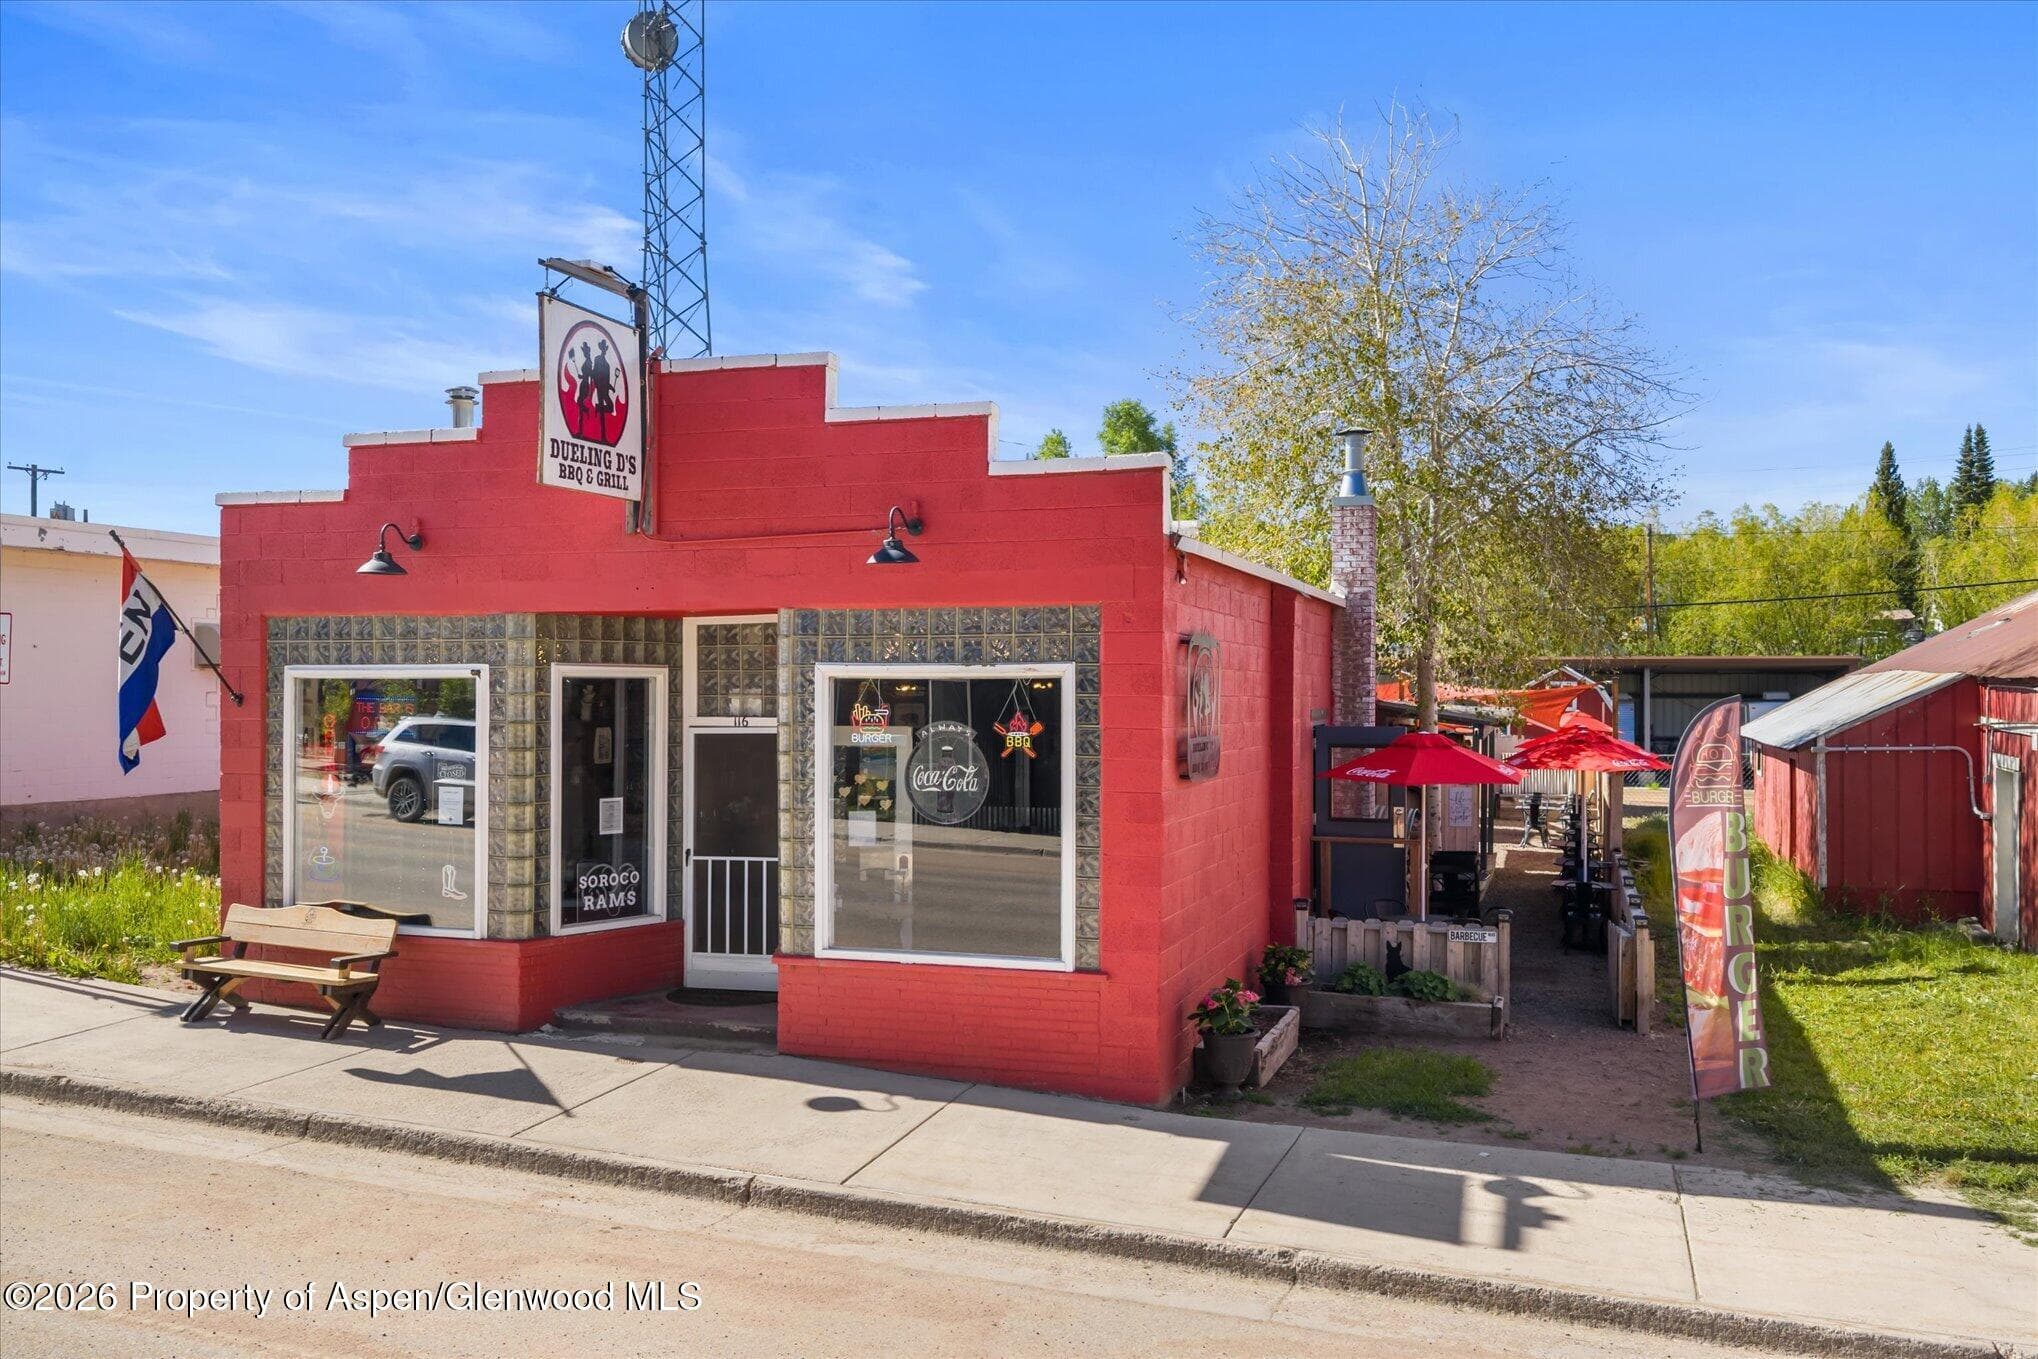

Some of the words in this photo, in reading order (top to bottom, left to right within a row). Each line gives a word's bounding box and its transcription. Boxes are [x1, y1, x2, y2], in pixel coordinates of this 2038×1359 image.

[550, 438, 612, 471] DUELING
[616, 452, 637, 475] D'S
[559, 463, 582, 486] BBQ
[586, 468, 593, 484] &
[597, 470, 629, 491] GRILL
[120, 589, 151, 665] EN
[734, 716, 749, 727] 116
[921, 723, 971, 738] ALWAYS
[851, 733, 892, 743] BURGER
[1006, 736, 1031, 748] BBQ
[913, 765, 979, 792] Coca-Cola
[579, 871, 640, 889] SOROCO
[583, 890, 637, 911] RAMS
[1450, 931, 1488, 941] BARBECUE
[1724, 811, 1772, 1089] BURGER
